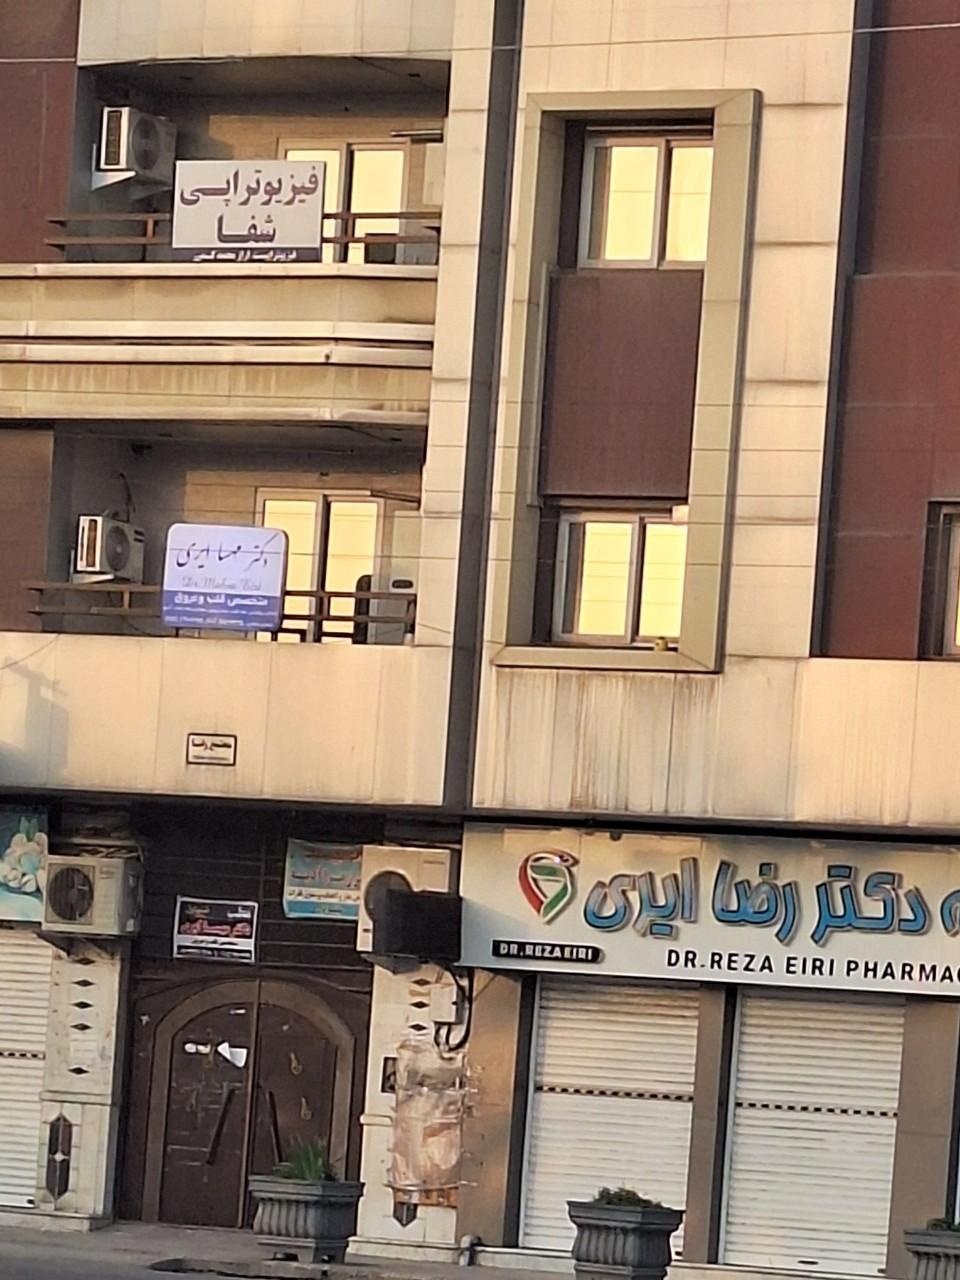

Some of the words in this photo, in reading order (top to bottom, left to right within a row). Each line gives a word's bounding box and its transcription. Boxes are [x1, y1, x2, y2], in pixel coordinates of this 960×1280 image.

[180, 166, 319, 207] فیزیوتراپی
[217, 214, 276, 243] شفا
[583, 856, 700, 940] ایری
[711, 859, 799, 945] رضا
[810, 864, 932, 947] دکتر
[786, 957, 835, 976] EIRI
